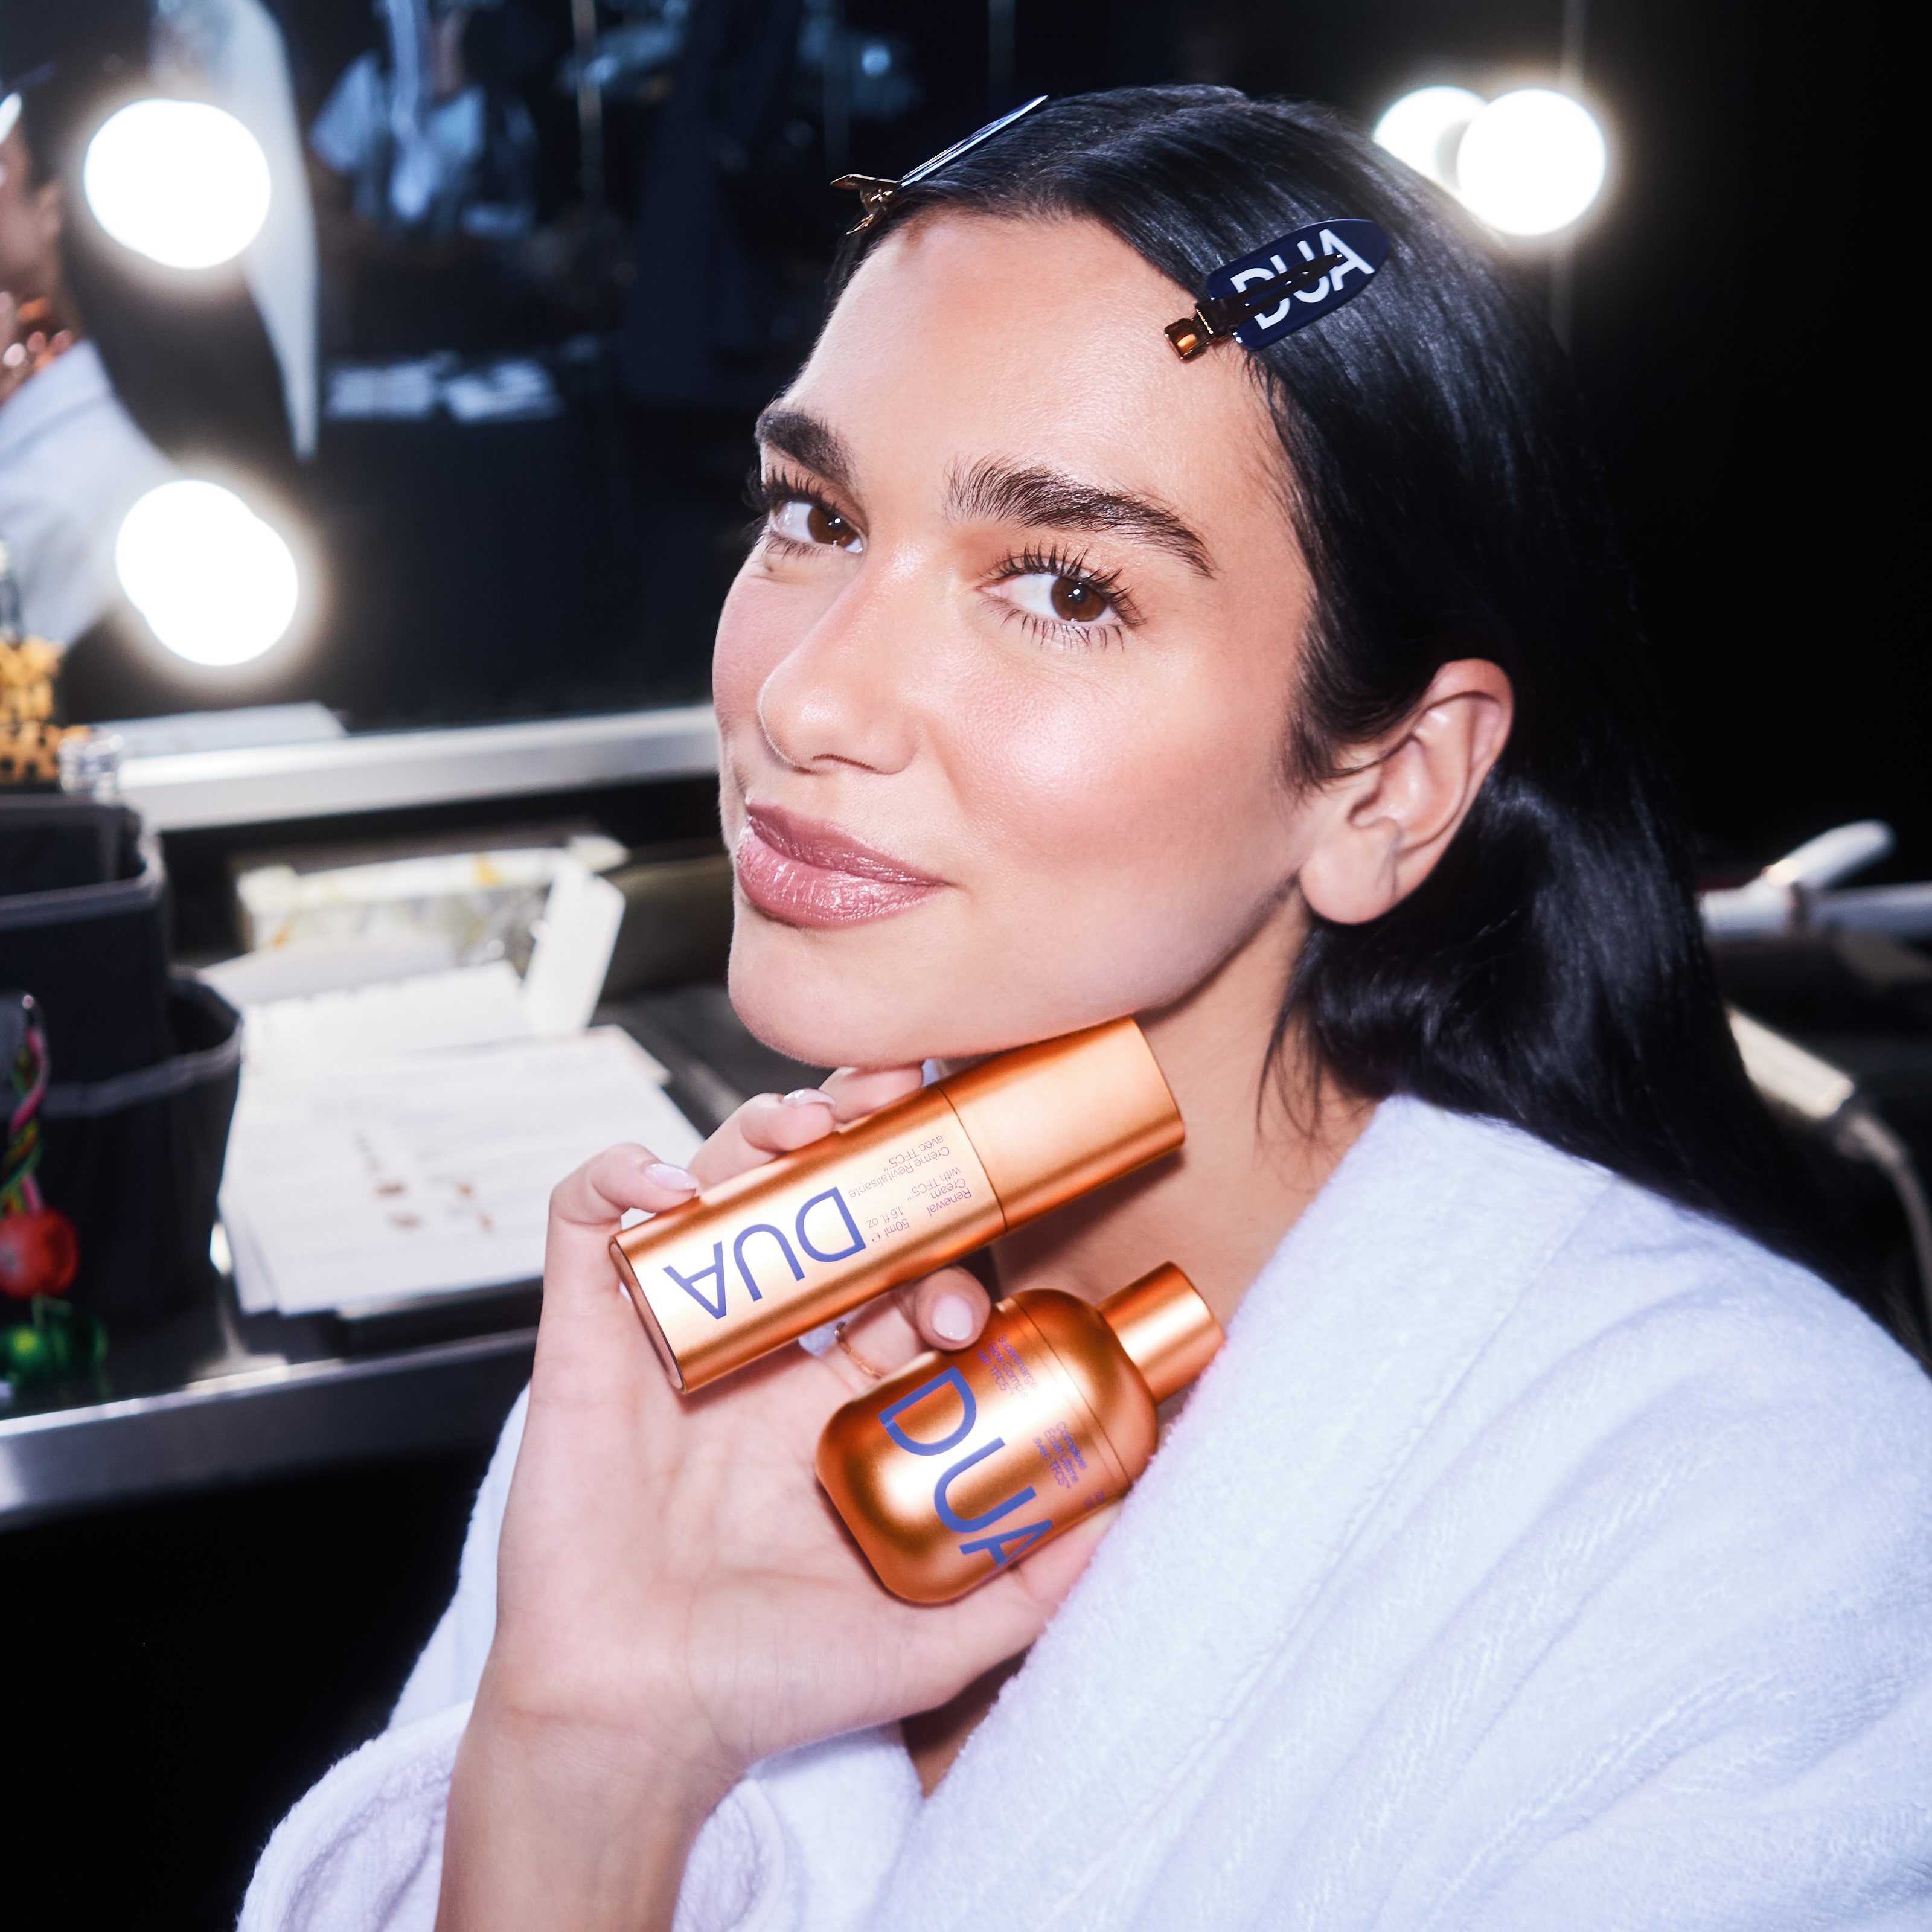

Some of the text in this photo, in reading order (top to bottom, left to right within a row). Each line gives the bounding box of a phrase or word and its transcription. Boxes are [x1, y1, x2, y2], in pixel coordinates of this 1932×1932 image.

[1230, 229, 1375, 330] DUA
[918, 1135, 944, 1151] avec
[848, 1146, 950, 1198] Crème Revitalisante
[939, 1167, 961, 1182] with
[927, 1188, 971, 1216] Renewal
[930, 1178, 966, 1198] Cream
[883, 1218, 910, 1238] 50ml
[663, 1186, 866, 1320] DUA
[878, 1366, 1053, 1568] DUA
